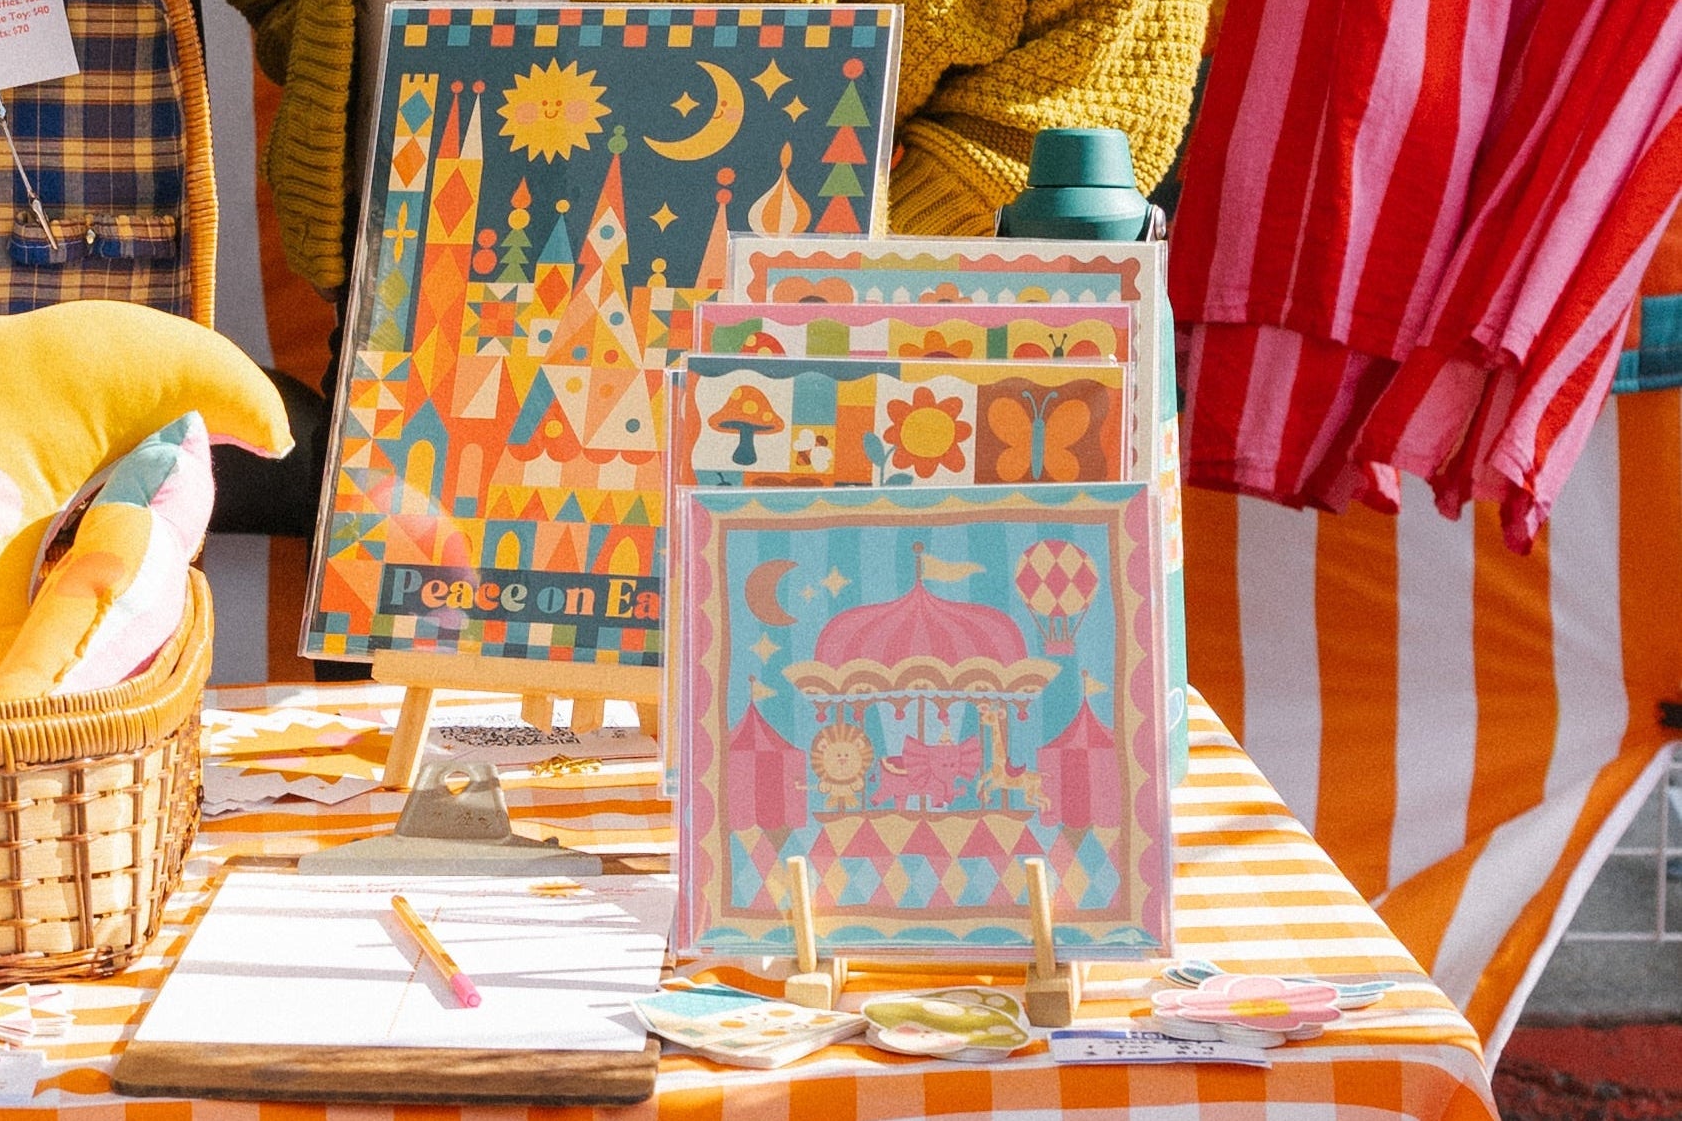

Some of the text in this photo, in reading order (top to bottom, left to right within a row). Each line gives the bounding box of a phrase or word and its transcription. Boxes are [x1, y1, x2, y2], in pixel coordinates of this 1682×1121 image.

[9, 11, 31, 22] Toy:
[13, 24, 29, 36] $70
[390, 568, 528, 612] Peace
[537, 585, 594, 615] on
